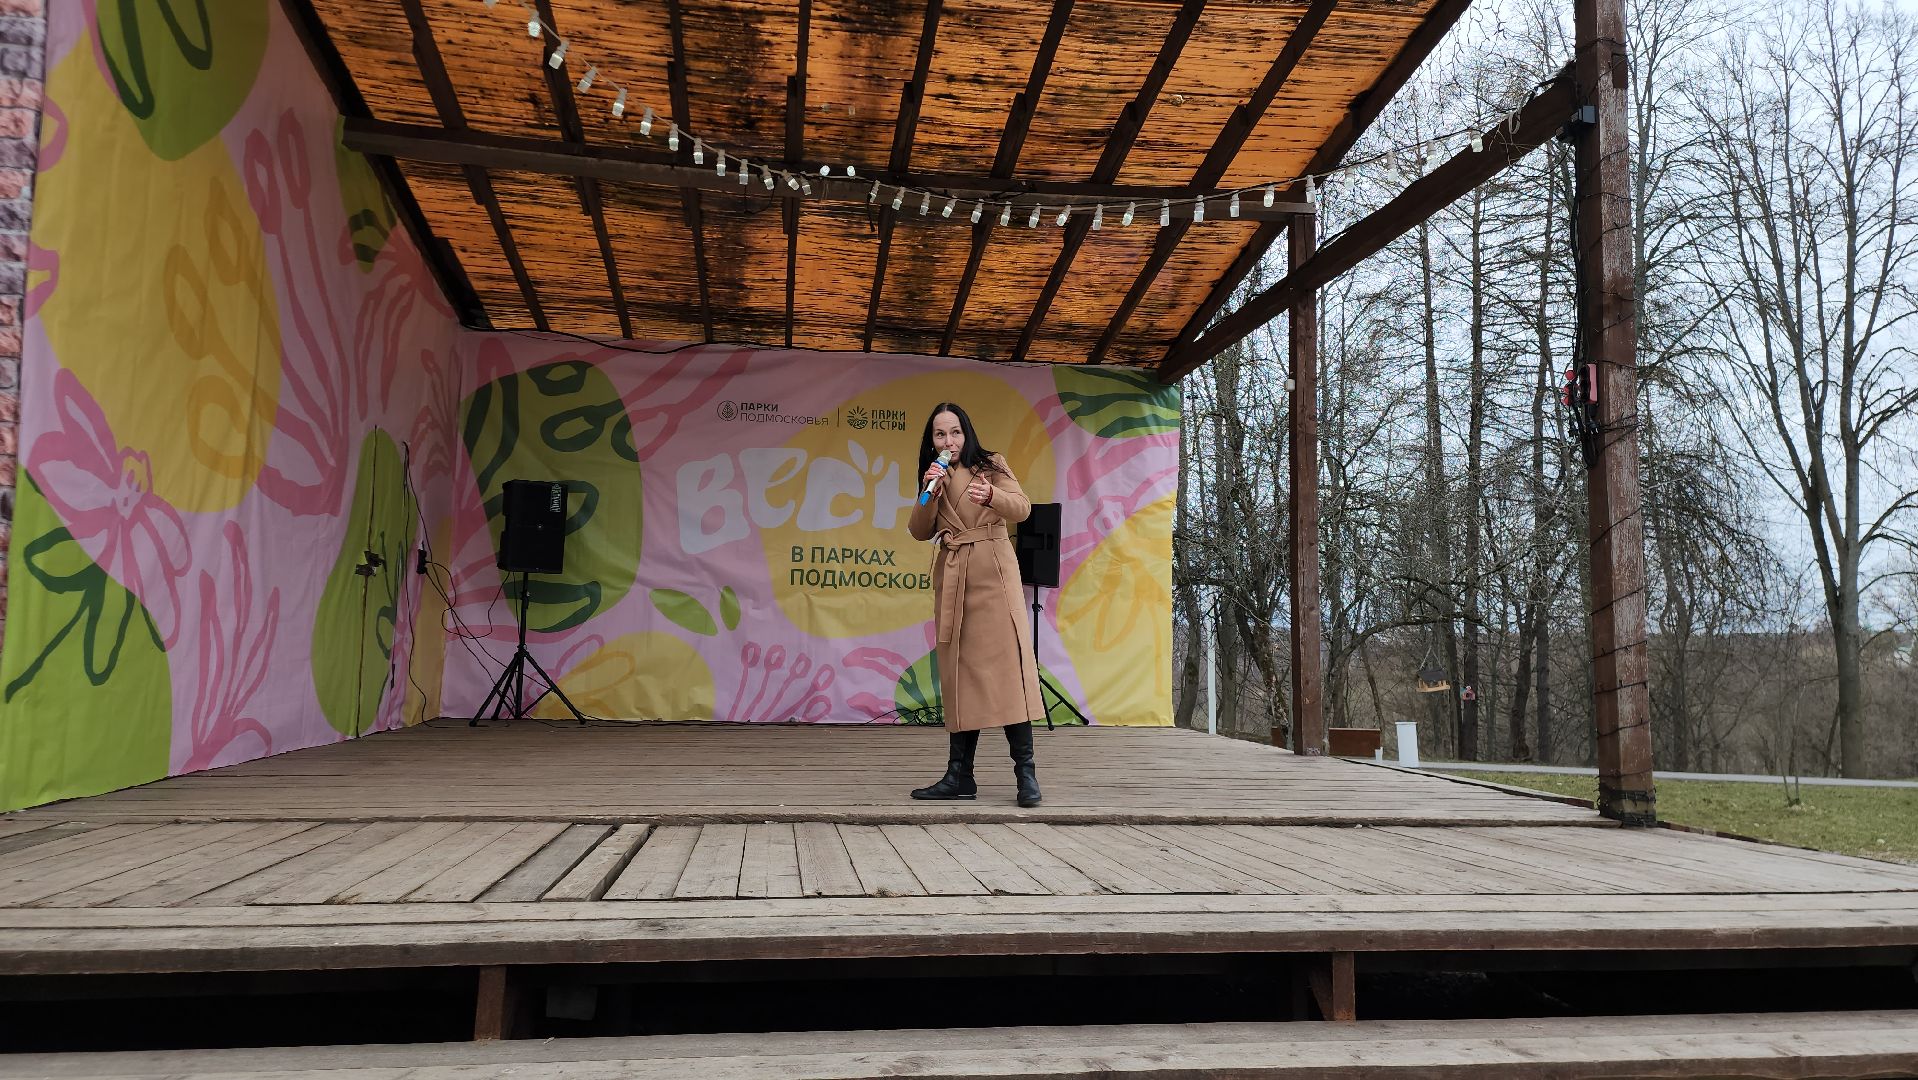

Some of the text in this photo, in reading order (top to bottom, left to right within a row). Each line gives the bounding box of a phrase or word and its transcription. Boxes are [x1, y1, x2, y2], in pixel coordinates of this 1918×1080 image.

[740, 402, 779, 412] ПАРКИ
[740, 412, 829, 426] ПОДМОСКОВЬЯ
[871, 409, 906, 420] ПАРКИ
[871, 420, 906, 431] ИСТРЫ
[791, 545, 897, 567] В ПАРКАХ
[790, 568, 935, 590] ПОДМОСКОВ
